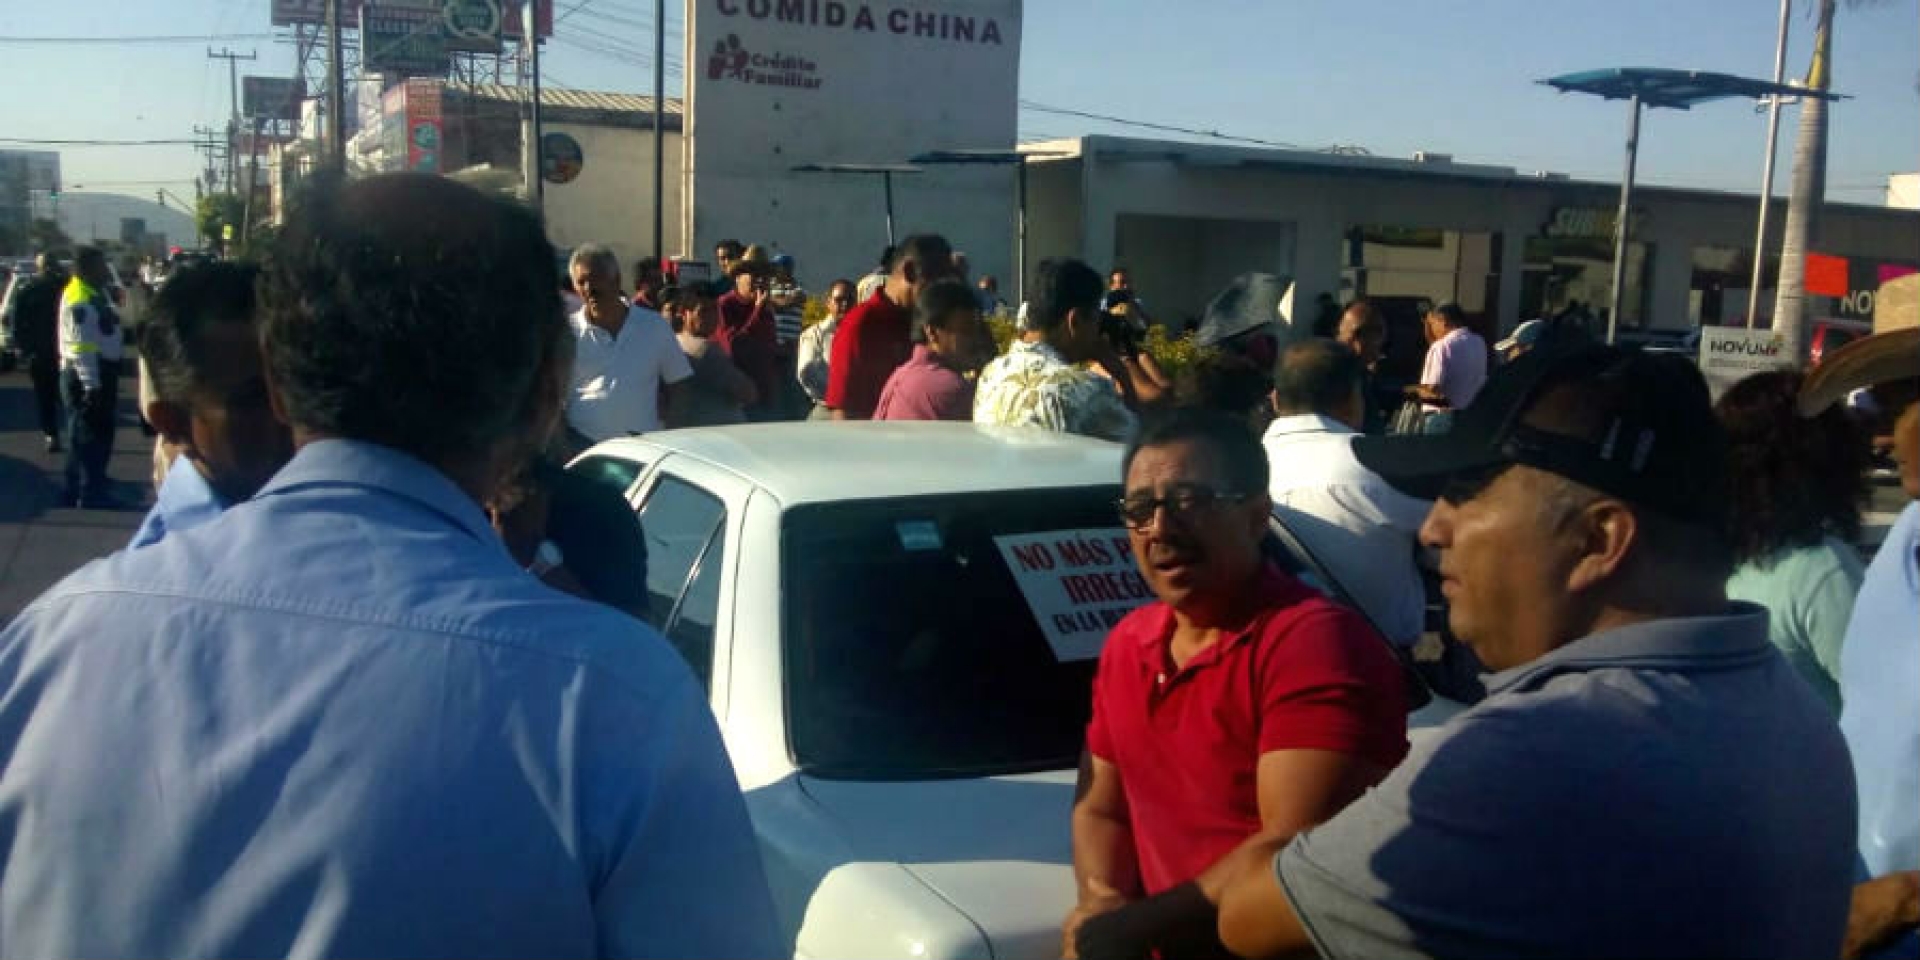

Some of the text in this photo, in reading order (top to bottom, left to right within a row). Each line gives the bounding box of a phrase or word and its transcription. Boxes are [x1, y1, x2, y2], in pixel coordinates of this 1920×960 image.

[716, 0, 1001, 45] COMIDA CHINA
[749, 51, 817, 72] Crédito
[744, 69, 823, 90] Familiar
[1841, 290, 1876, 315] NO
[1011, 541, 1056, 572] NO
[1054, 531, 1113, 568] MÁS
[1053, 613, 1080, 635] EN
